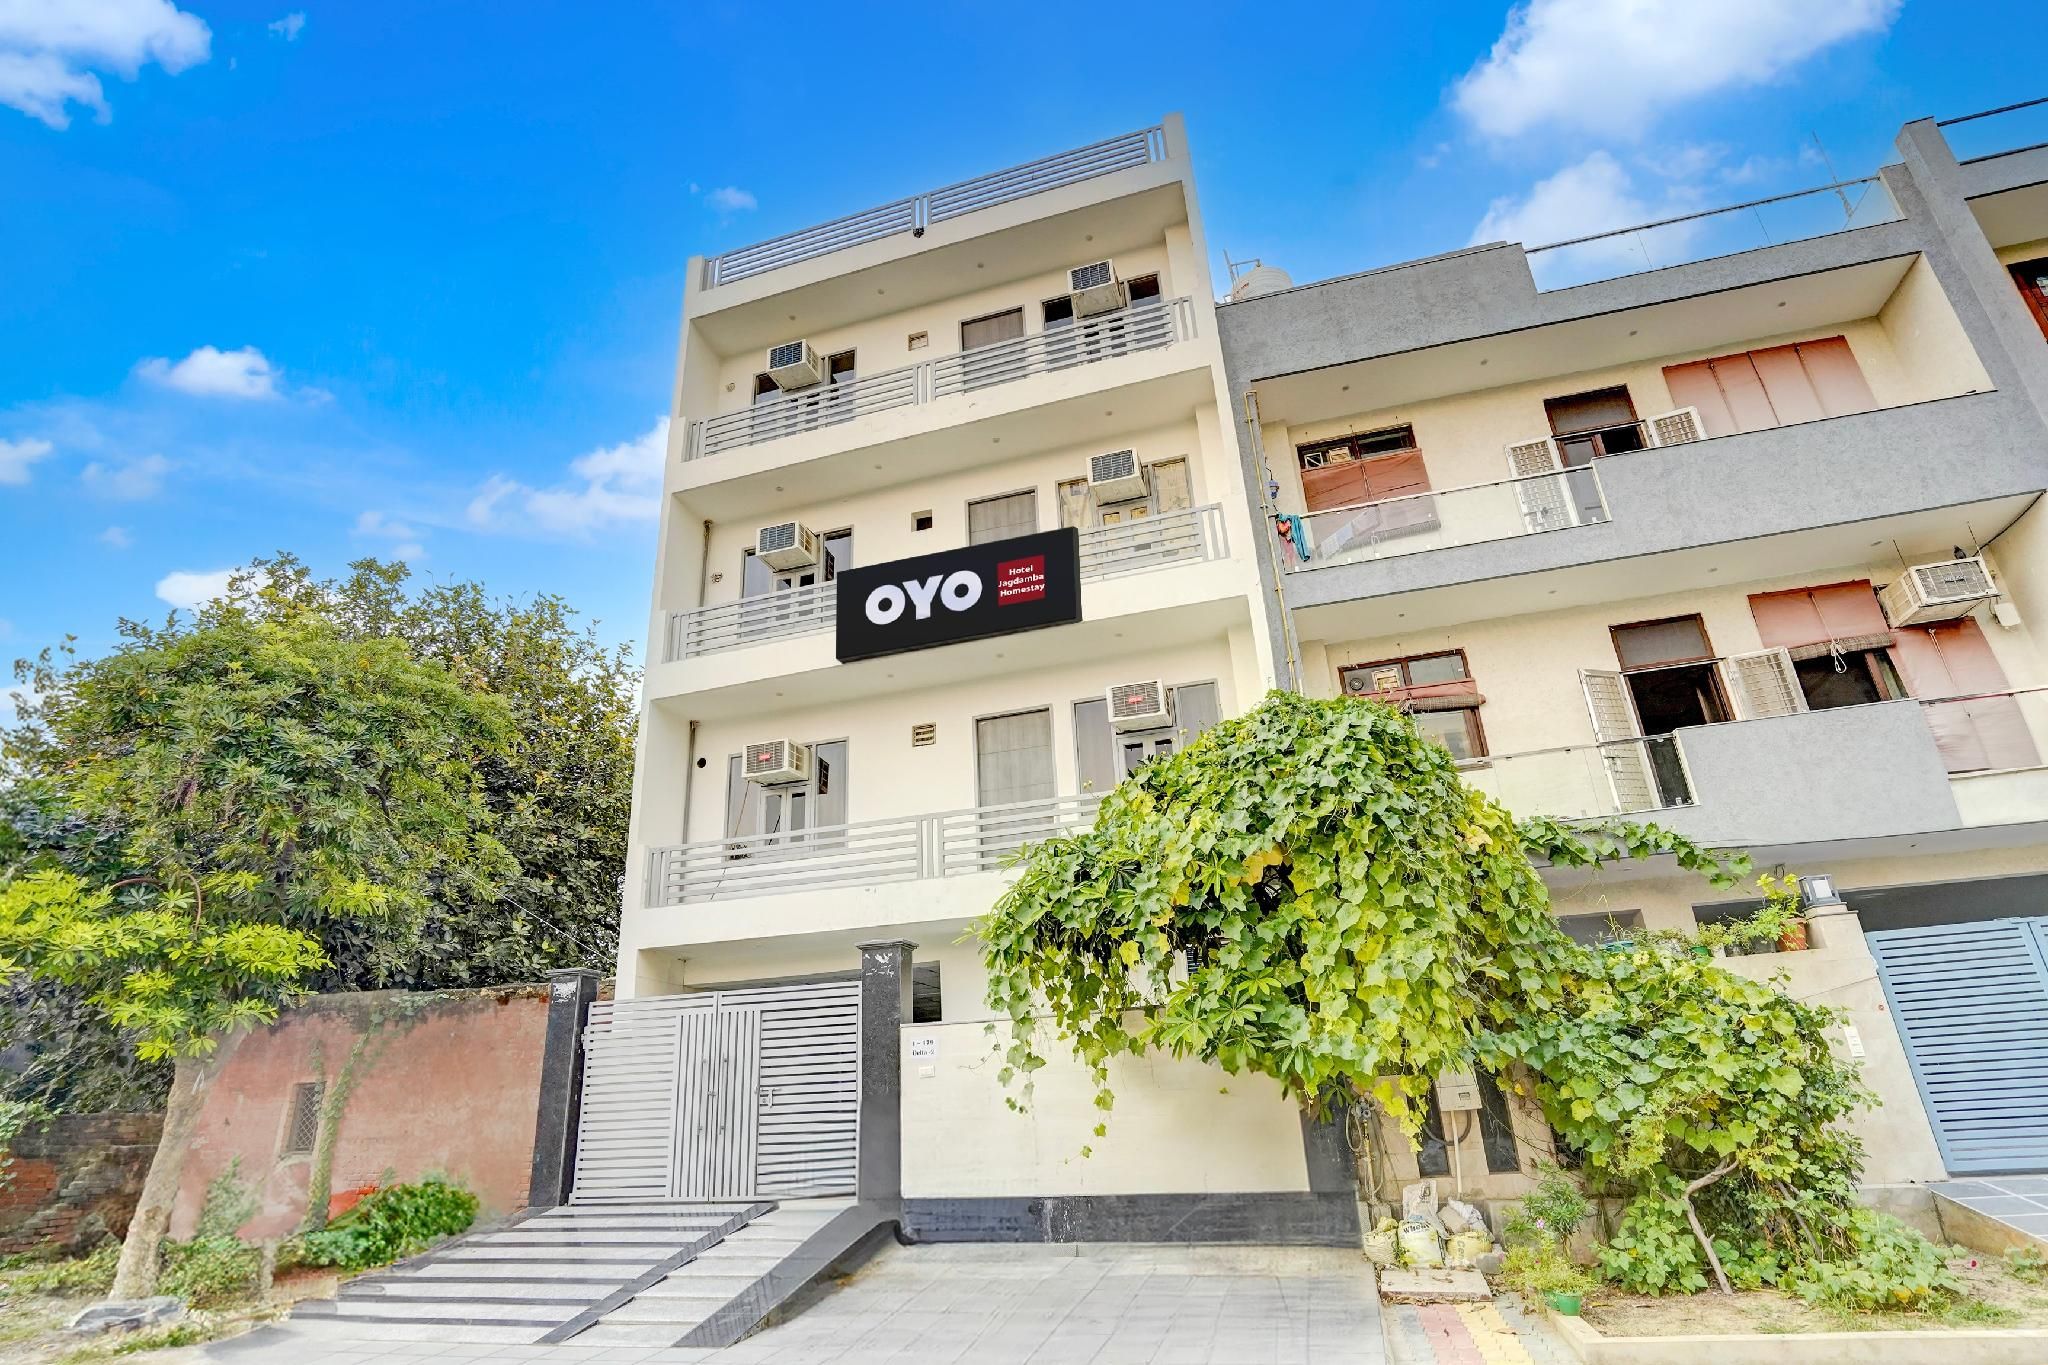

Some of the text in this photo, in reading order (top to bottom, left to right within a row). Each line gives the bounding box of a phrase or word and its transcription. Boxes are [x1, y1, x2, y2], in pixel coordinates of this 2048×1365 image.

[1009, 565, 1033, 575] Hotel
[998, 574, 1045, 588] Jagdamba
[1000, 584, 1045, 597] Homestay
[865, 570, 983, 625] OYO
